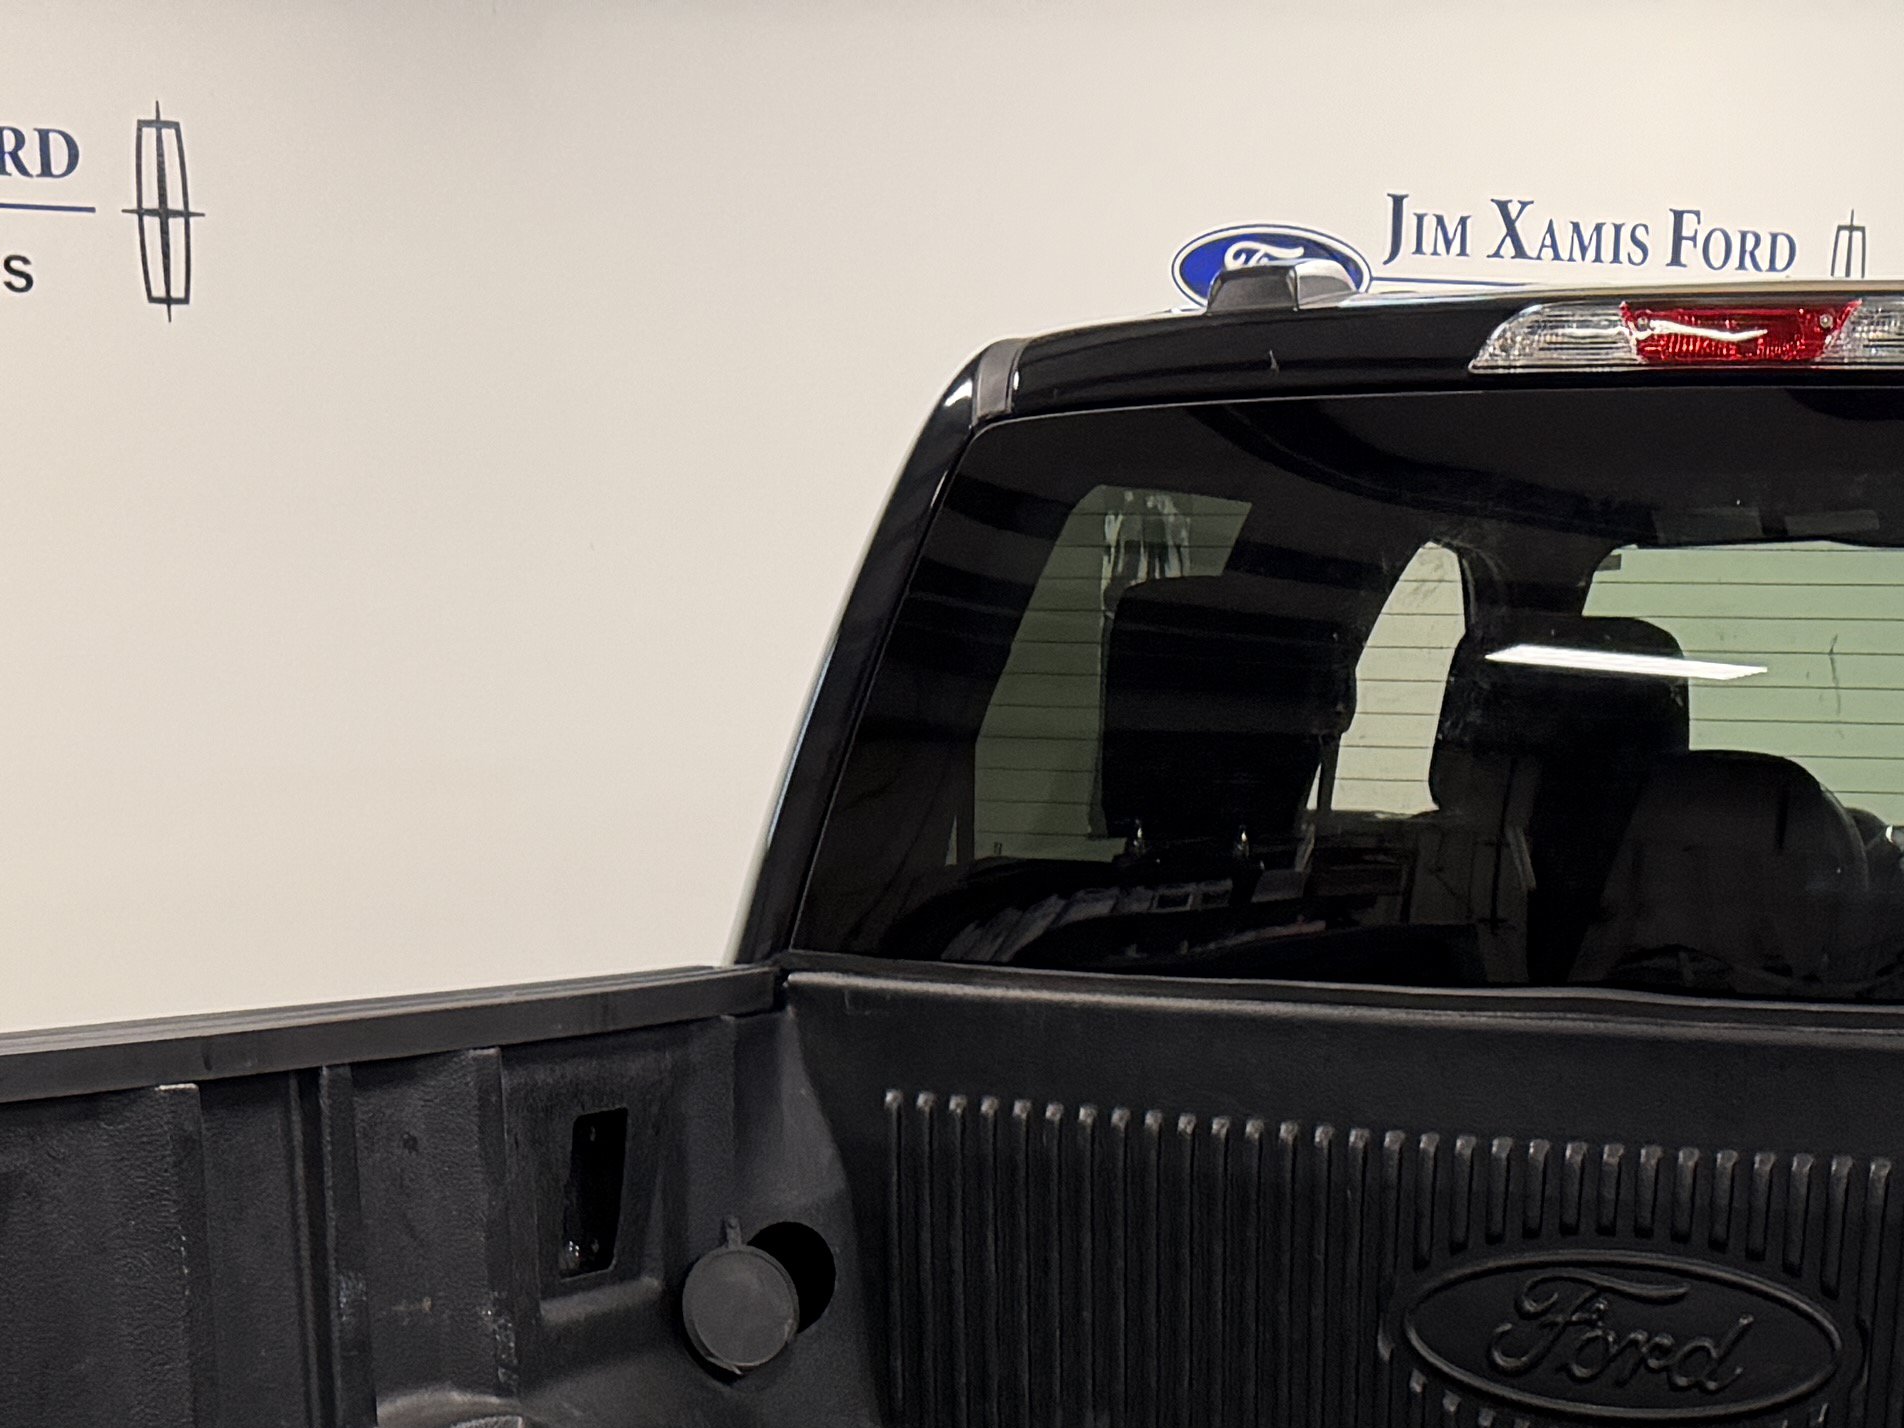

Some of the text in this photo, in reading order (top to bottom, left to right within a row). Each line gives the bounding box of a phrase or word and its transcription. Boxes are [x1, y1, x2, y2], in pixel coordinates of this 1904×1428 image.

[1382, 193, 1471, 266] JIM
[1485, 198, 1649, 267] XAMIS
[1665, 208, 1797, 273] FORD
[1490, 1267, 1754, 1394] Ford
